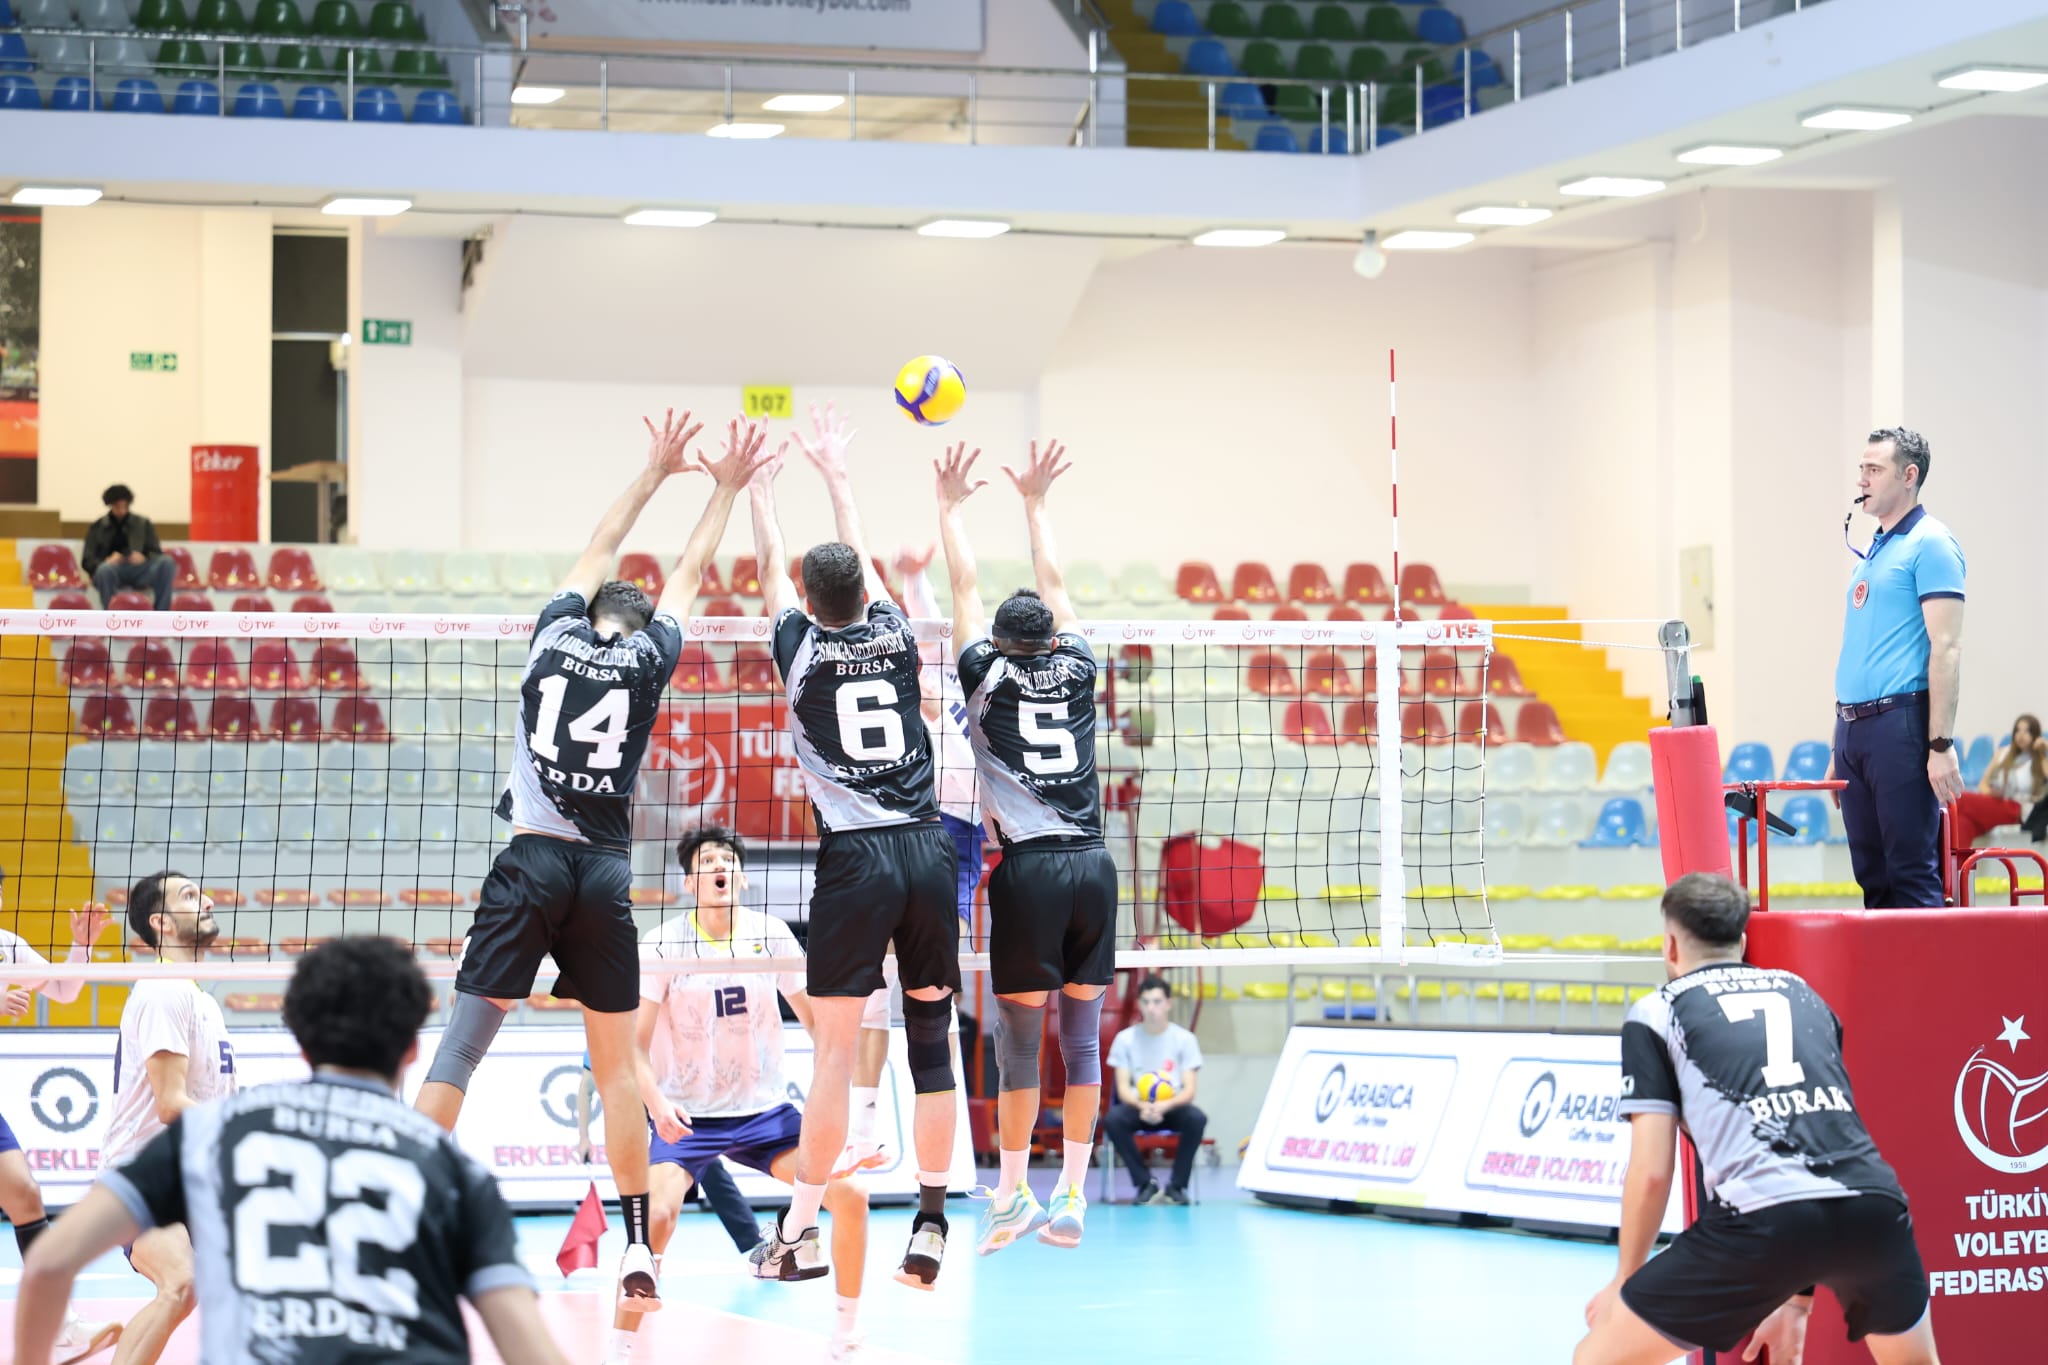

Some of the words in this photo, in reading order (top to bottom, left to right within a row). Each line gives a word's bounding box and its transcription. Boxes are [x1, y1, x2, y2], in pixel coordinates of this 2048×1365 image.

[750, 394, 787, 411] 107
[56, 618, 77, 627] TVF
[123, 619, 143, 628] TVF
[189, 620, 209, 629] TVF
[255, 621, 275, 630] TVF
[321, 622, 341, 631] TVF
[386, 622, 406, 632] TVF
[450, 623, 471, 632] TVF
[515, 624, 535, 633] TVF
[706, 625, 726, 634] TVF
[1442, 623, 1478, 639] TVF
[1138, 629, 1156, 637] TVF
[1198, 629, 1216, 637] TVF
[1258, 629, 1276, 637] TVF
[1317, 629, 1335, 638] TVF
[561, 656, 622, 681] BURSA
[836, 657, 896, 676] BURSA
[529, 673, 630, 770] 14
[835, 678, 906, 761] 6
[738, 722, 797, 759] TÜR
[1018, 700, 1079, 775] 5
[774, 767, 806, 796] FE
[1703, 978, 1789, 995] BURSA
[715, 986, 748, 1018] 12
[1716, 991, 1806, 1088] 7
[1345, 1083, 1414, 1109] ARABICA
[1748, 1086, 1853, 1122] BURAK
[1555, 1092, 1632, 1123] ARABI
[274, 1103, 397, 1150] BURSA
[494, 1145, 608, 1167] ERKEKE
[2010, 1161, 2027, 1169] 1958
[233, 1131, 427, 1320] 22
[1954, 1229, 2048, 1258] VOLEYB
